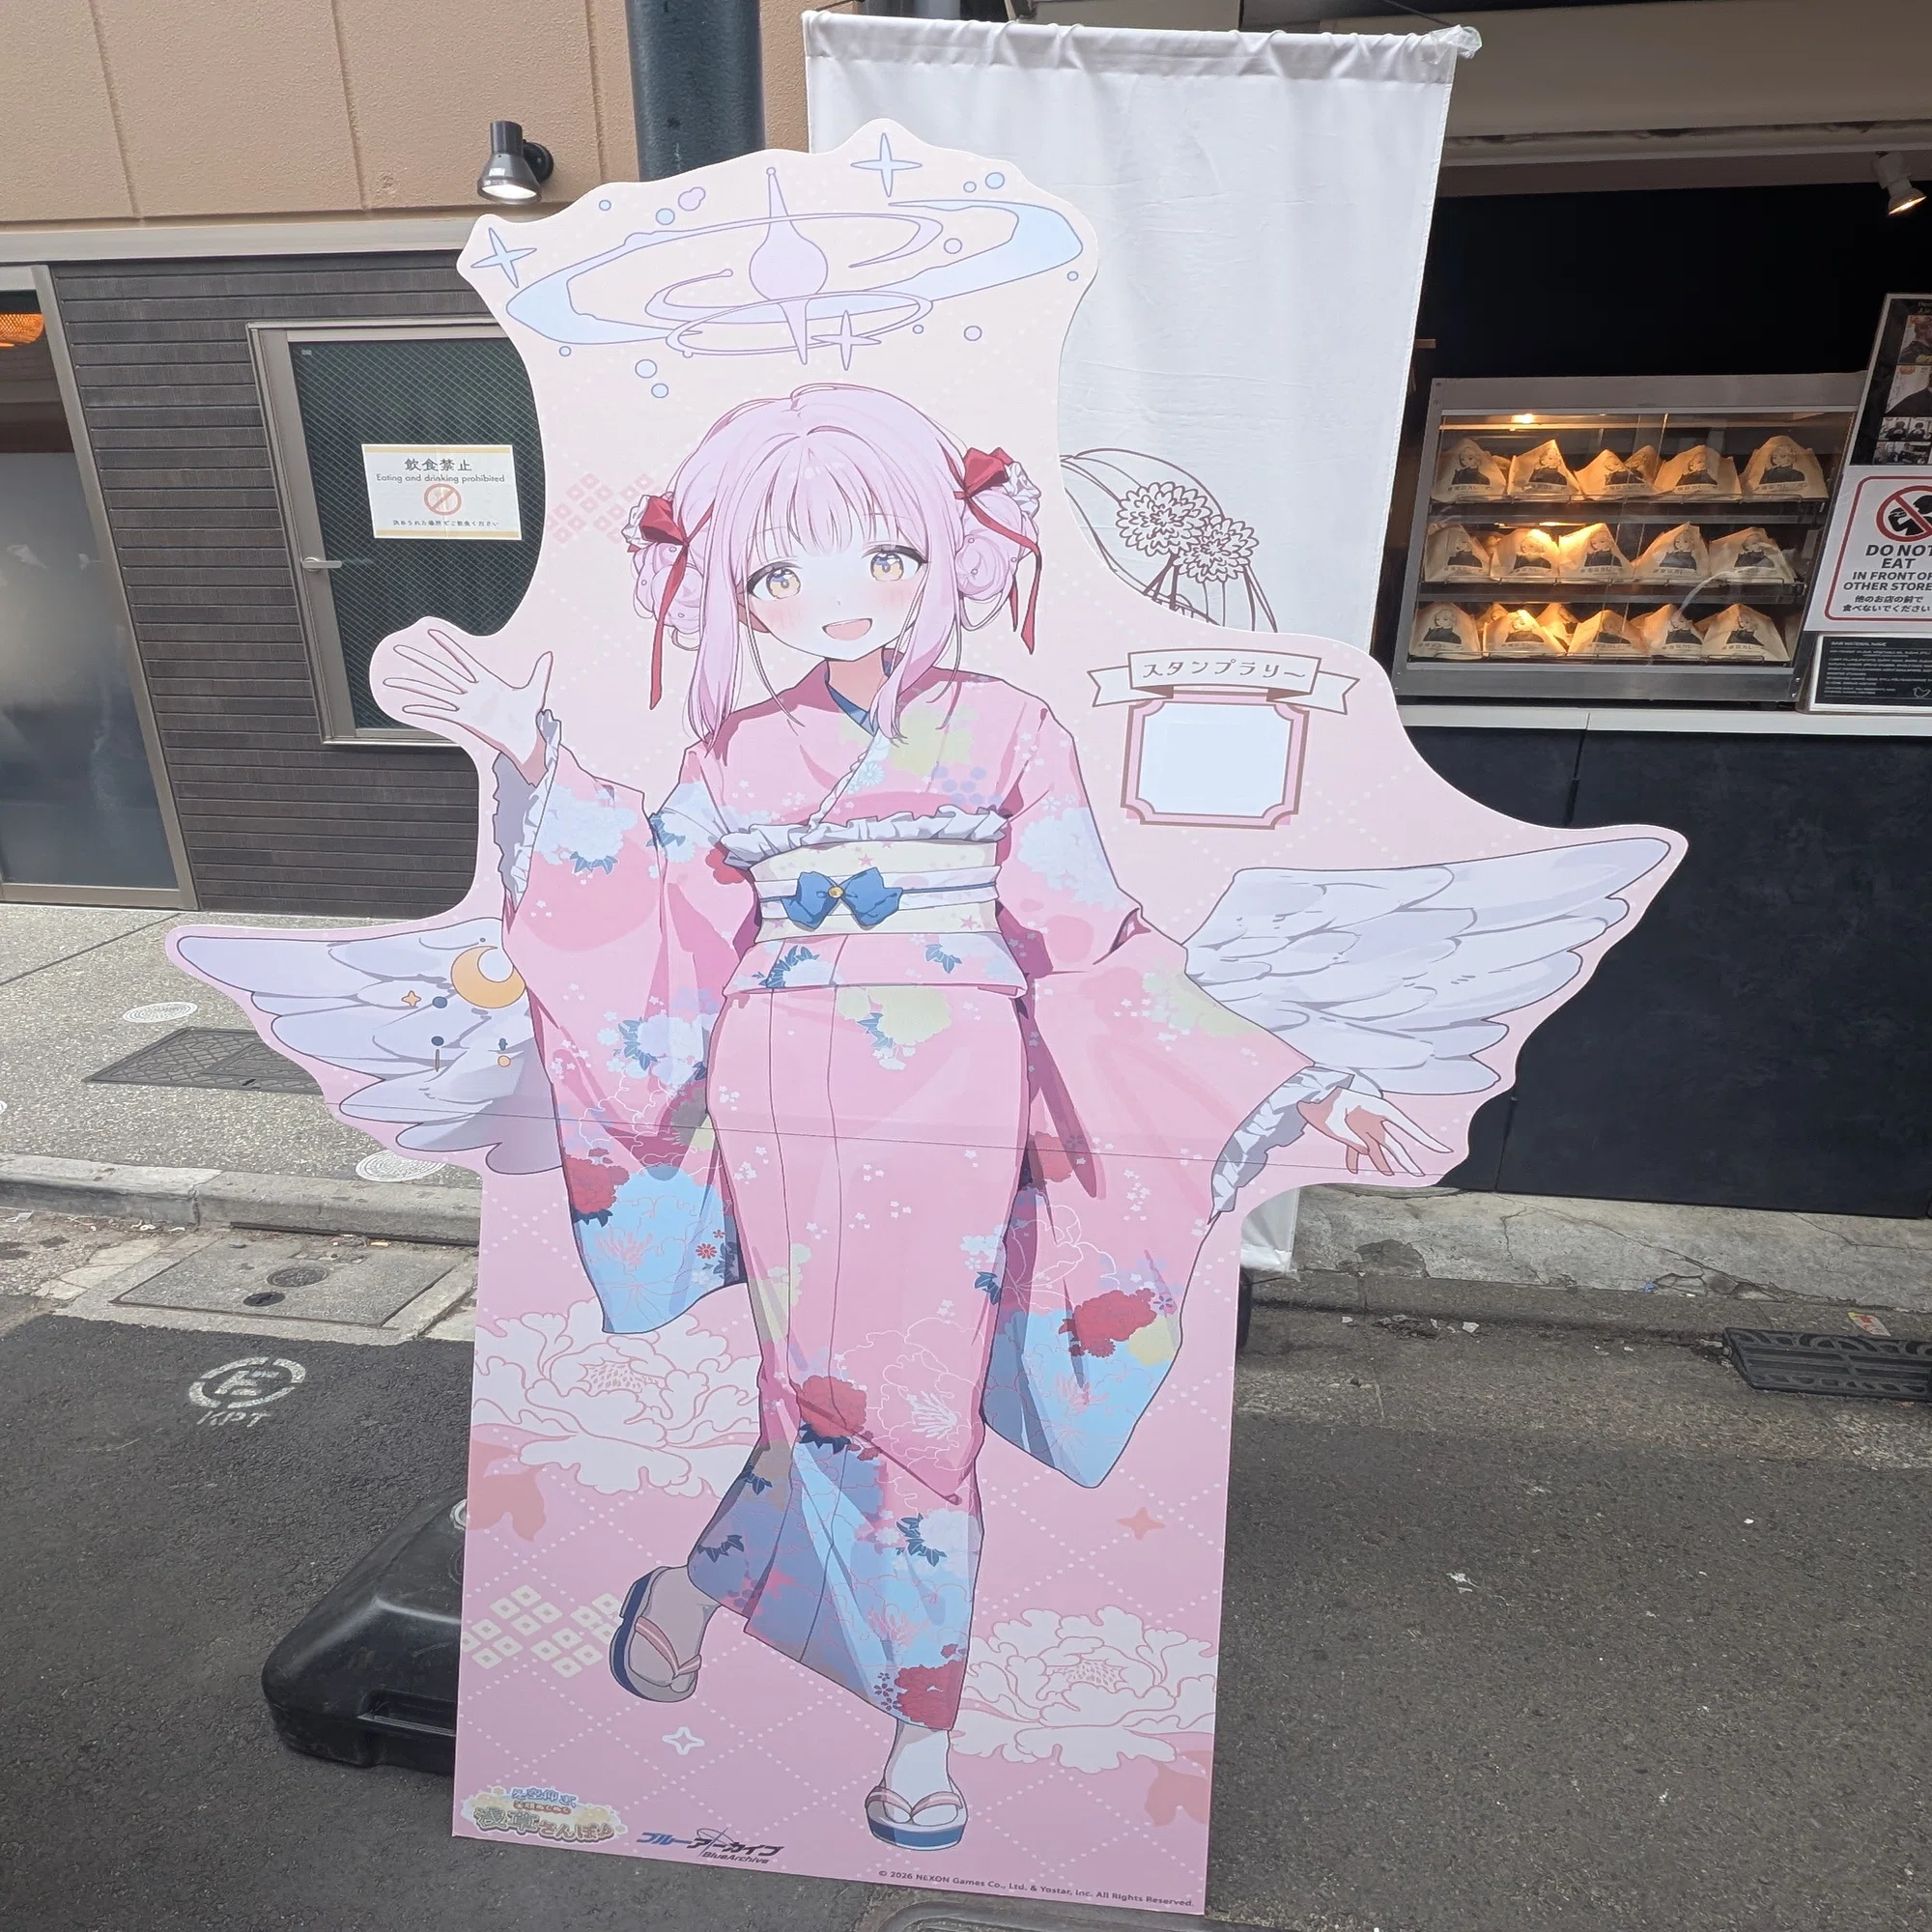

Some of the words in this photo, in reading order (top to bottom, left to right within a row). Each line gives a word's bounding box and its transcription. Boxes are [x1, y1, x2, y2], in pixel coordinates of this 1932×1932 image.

[404, 458, 472, 471] 飲食禁止
[377, 473, 403, 483] Eating
[424, 474, 459, 484] drinking
[462, 474, 505, 484] prohibited
[1865, 544, 1894, 556] DO
[1881, 557, 1916, 569] EAT
[1852, 571, 1867, 581] IN
[1869, 572, 1916, 581] FRONT
[1843, 582, 1889, 591] OTHER
[1855, 595, 1923, 604] 他のお店の前で
[1842, 604, 1931, 612] 食べないでください
[890, 1871, 913, 1880] 2026
[916, 1874, 950, 1883] NEXON
[952, 1877, 985, 1887] Games
[987, 1881, 1006, 1889] Co.,
[1009, 1882, 1028, 1891] Ltd.
[1040, 1886, 1072, 1895] Yostar,
[1075, 1889, 1094, 1897] Inc.
[1111, 1892, 1143, 1902] Rights
[1146, 1895, 1195, 1907] Reserved.
